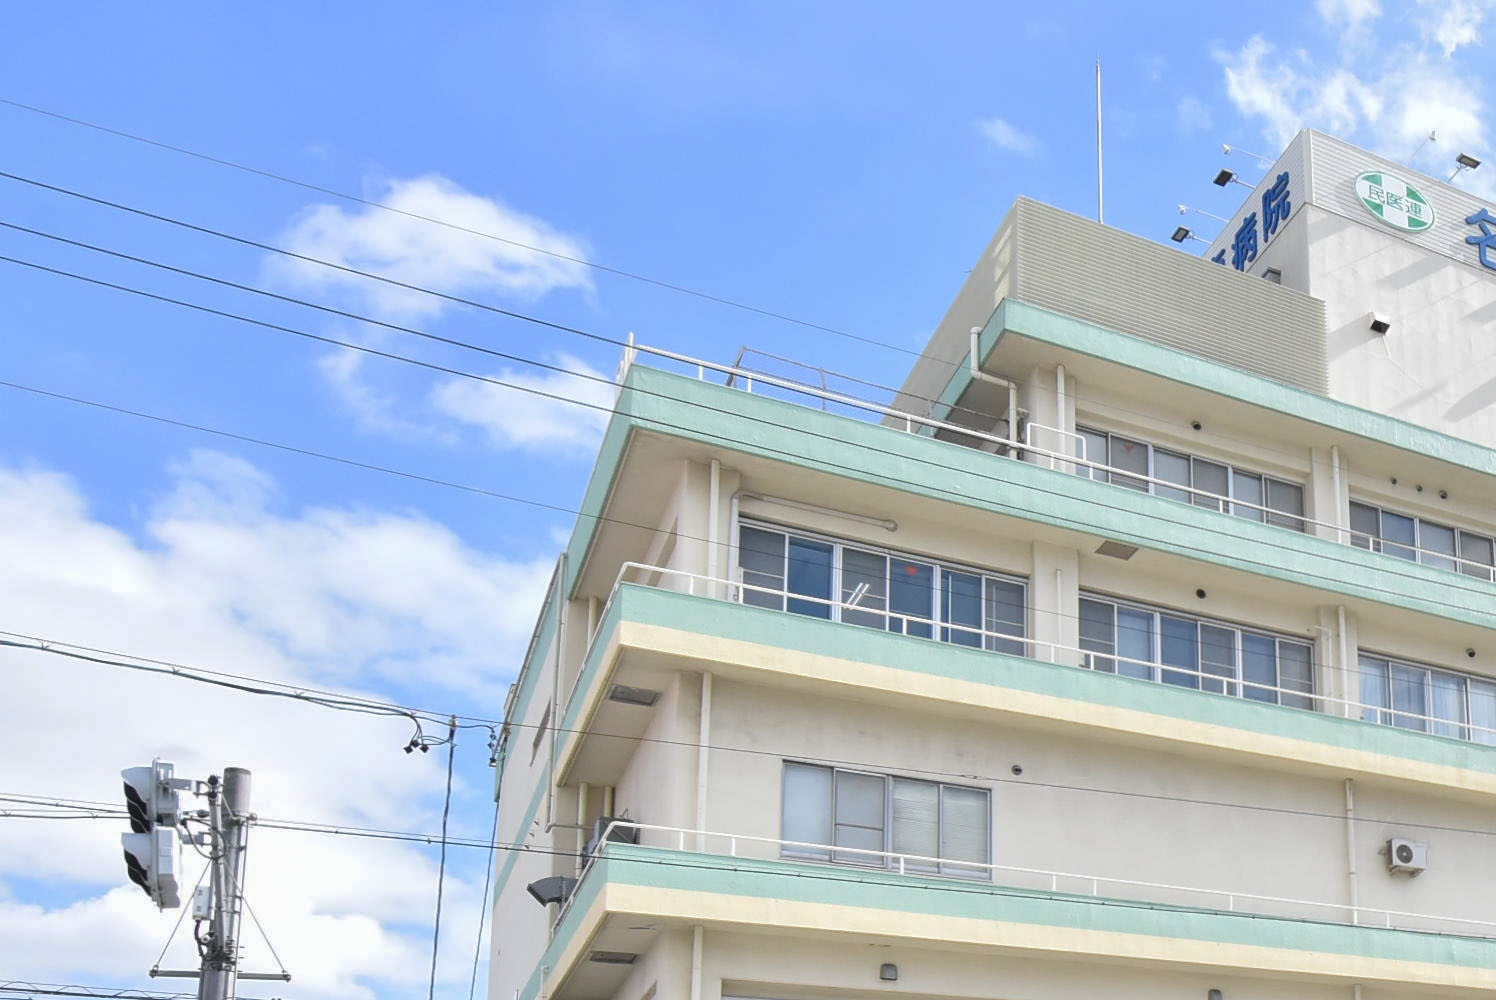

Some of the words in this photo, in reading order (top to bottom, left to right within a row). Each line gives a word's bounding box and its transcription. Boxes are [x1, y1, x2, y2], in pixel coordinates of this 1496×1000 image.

[1211, 171, 1291, 272] 病院
[1368, 184, 1425, 218] 民医連
